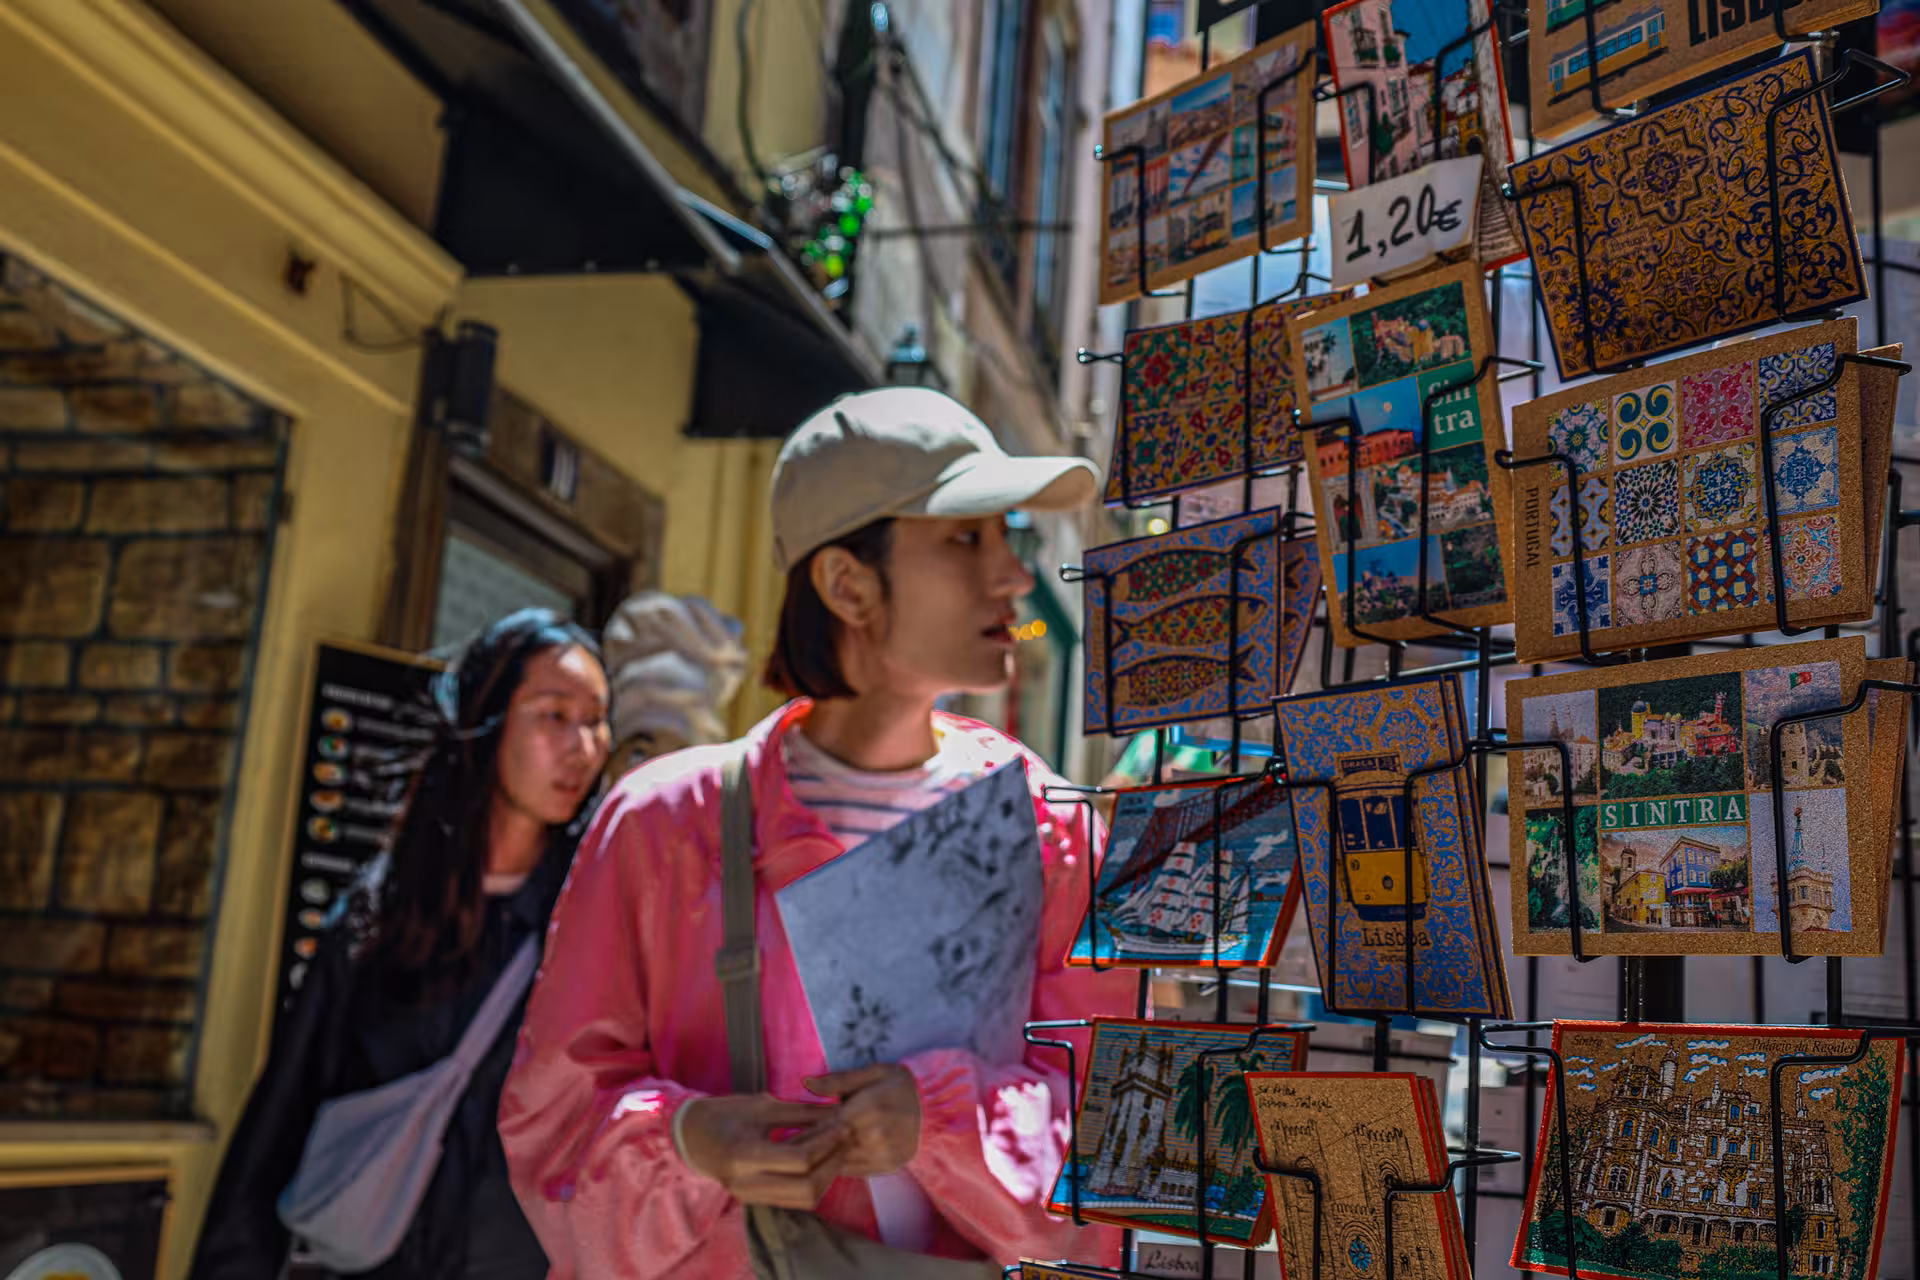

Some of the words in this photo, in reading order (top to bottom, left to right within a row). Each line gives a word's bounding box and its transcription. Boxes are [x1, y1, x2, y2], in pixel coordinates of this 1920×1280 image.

[1345, 183, 1462, 262] 1,20€
[1432, 409, 1476, 435] tra
[1524, 486, 1541, 570] PORTUGAL
[1605, 796, 1744, 827] SINTRA
[1573, 1034, 1605, 1047] Sintra
[1751, 1038, 1792, 1051] Palácio
[1795, 1039, 1809, 1051] da
